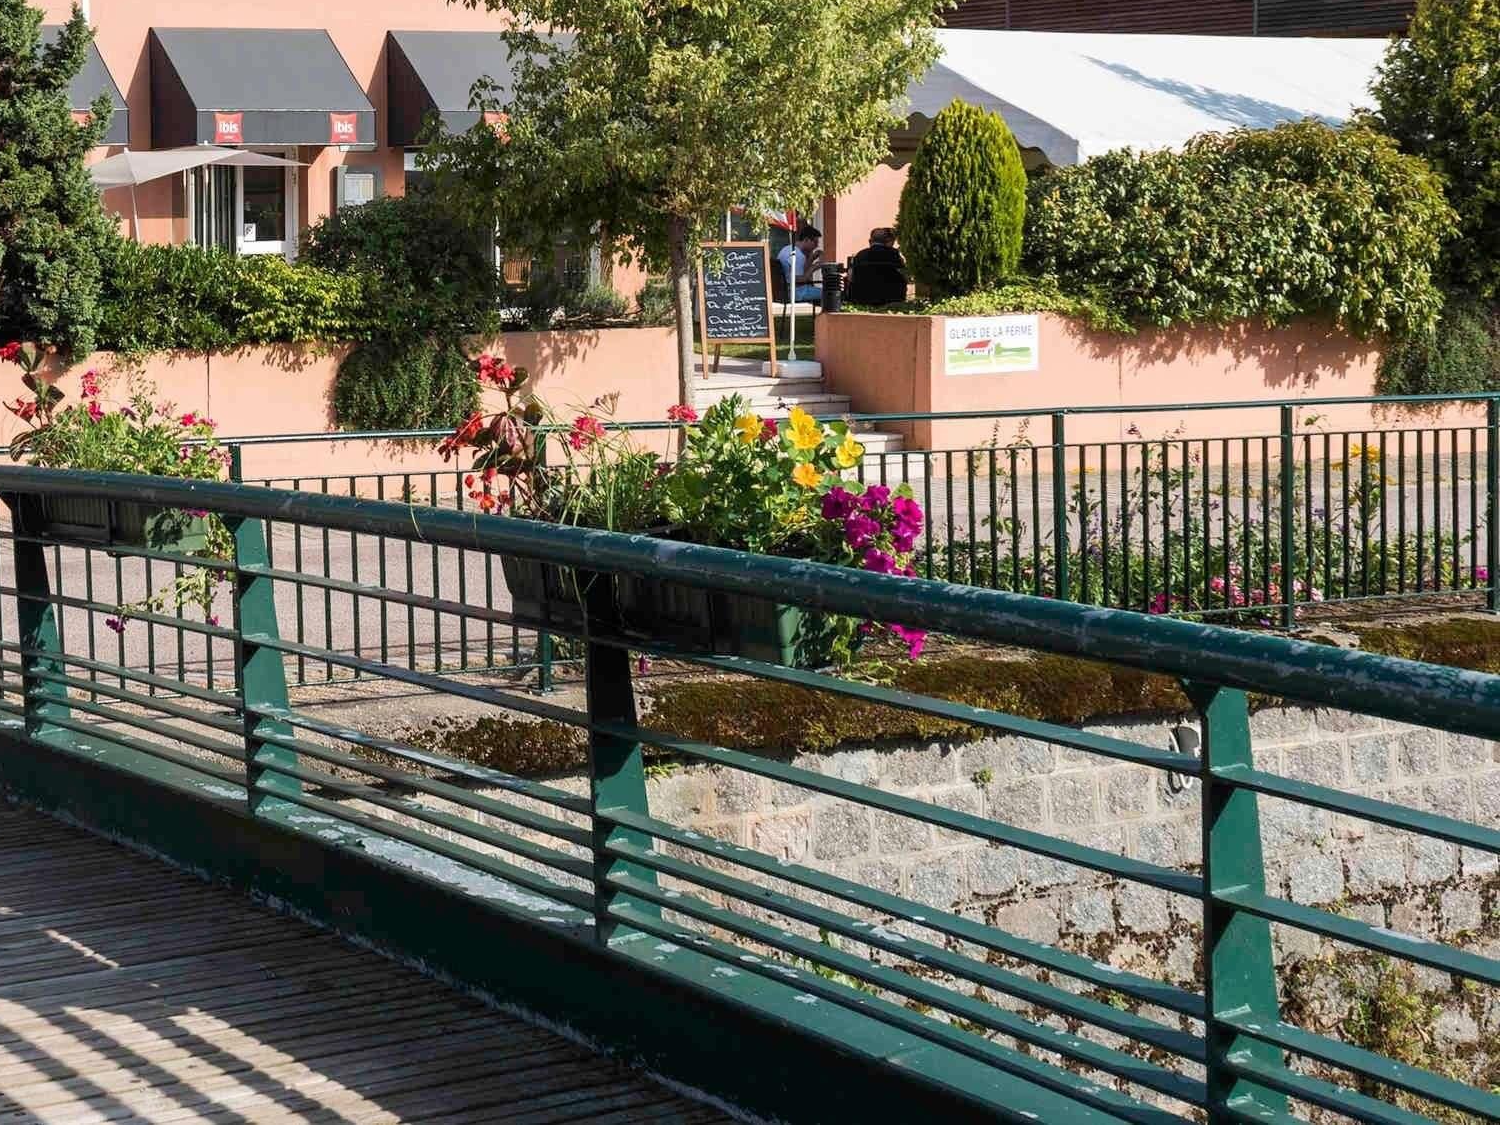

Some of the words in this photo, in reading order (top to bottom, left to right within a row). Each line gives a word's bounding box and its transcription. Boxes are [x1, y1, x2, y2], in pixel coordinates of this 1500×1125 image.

[219, 121, 239, 133] ibis
[334, 121, 354, 133] ibis
[949, 327, 977, 340] GLACE
[980, 327, 990, 338] DE
[993, 326, 1003, 338] LA
[1005, 324, 1033, 337] FERME
